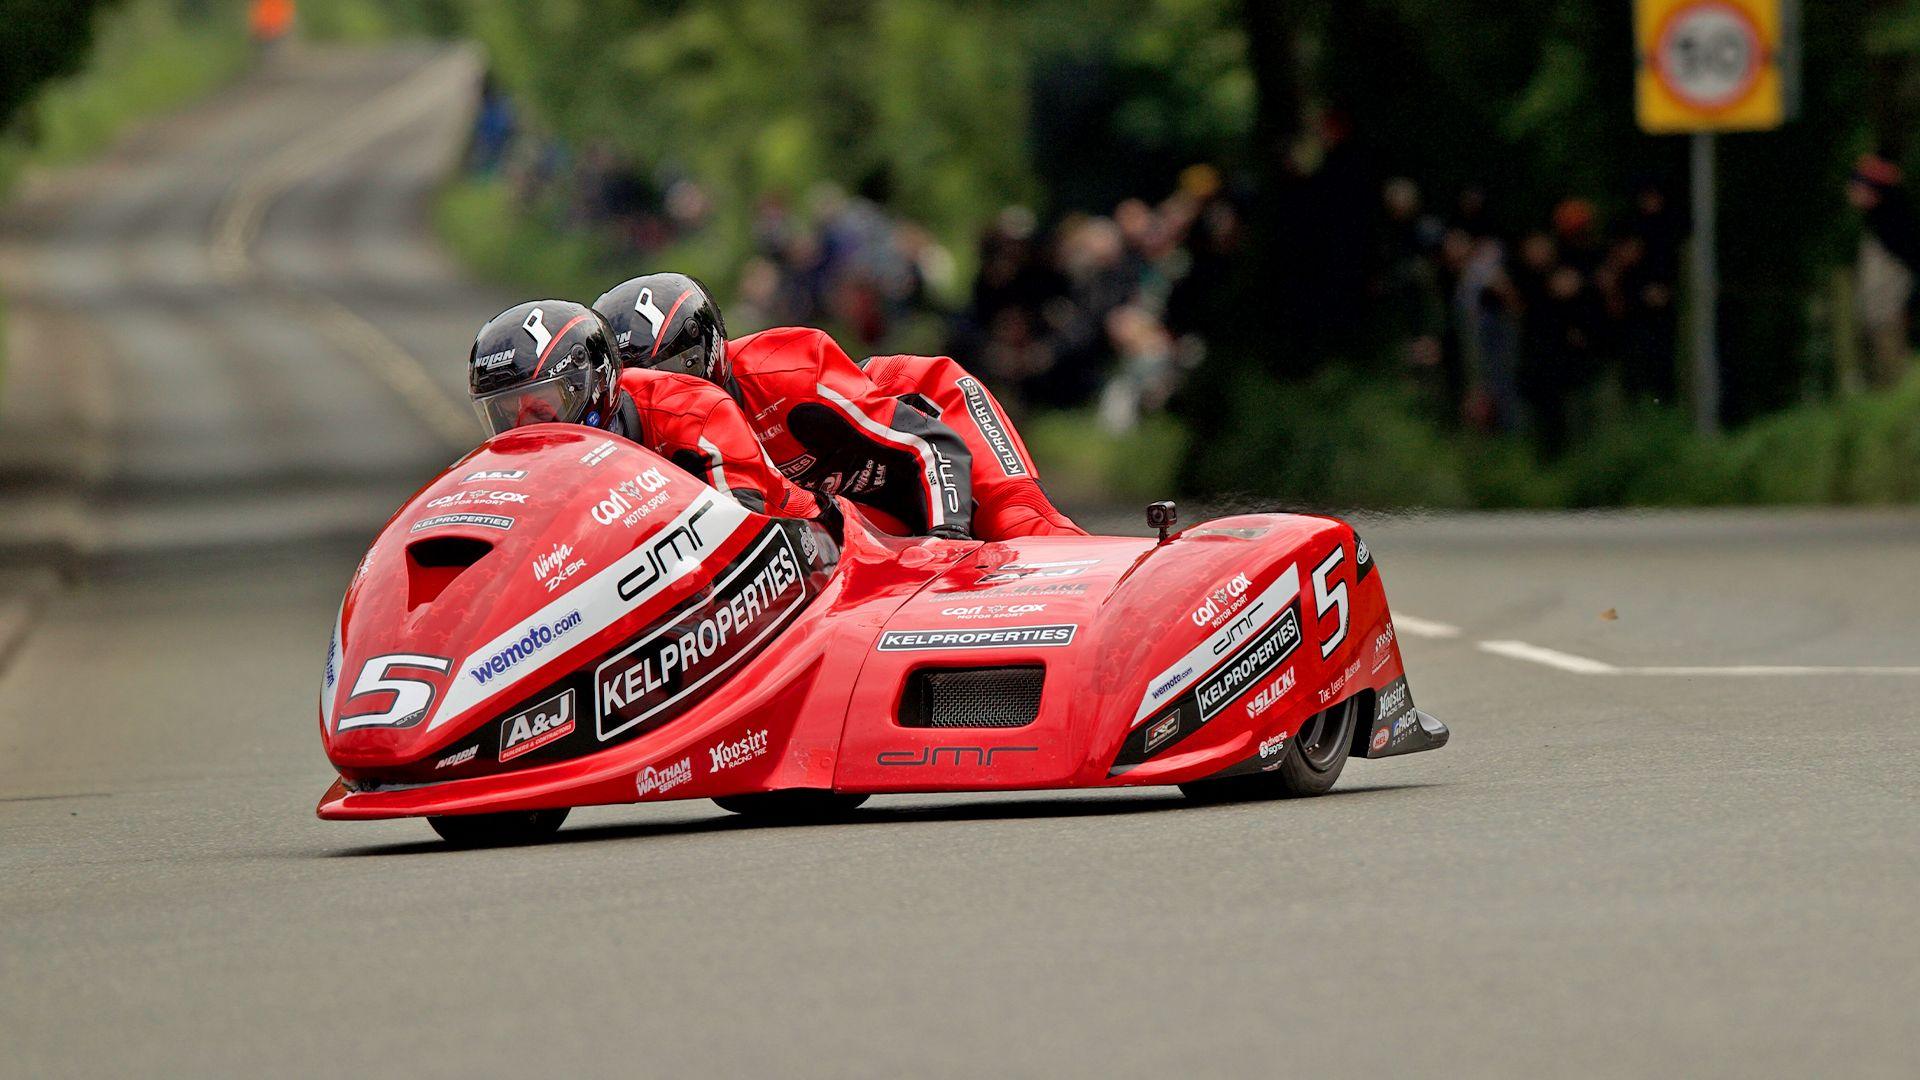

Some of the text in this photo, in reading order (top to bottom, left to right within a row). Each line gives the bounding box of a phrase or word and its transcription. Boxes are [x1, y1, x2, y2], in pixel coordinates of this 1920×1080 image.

[475, 349, 516, 371] NOLAN
[965, 378, 1021, 474] KELPROPERTIES
[414, 514, 510, 530] KELPROPERTIES
[440, 500, 472, 508] MOTOR
[623, 491, 671, 528] MOTOR SPORT
[533, 543, 573, 582] Ninja
[1212, 594, 1248, 628] MOTOR SPORT
[1312, 545, 1349, 662] 5
[471, 609, 582, 685] wemoto.com
[603, 546, 796, 717] KELPROPERTIES
[886, 629, 1069, 646] KELPROPERTIES
[1151, 667, 1194, 700] wemoto.com
[1201, 618, 1296, 711] KELPROPERTIES
[337, 653, 454, 733] 5
[505, 693, 570, 749] A&J
[435, 744, 479, 770] NOLAN
[709, 729, 768, 773] Hoosier
[728, 747, 768, 769] RACING TIRE
[637, 757, 691, 796] WALTHAM
[658, 769, 692, 794] SERVICES
